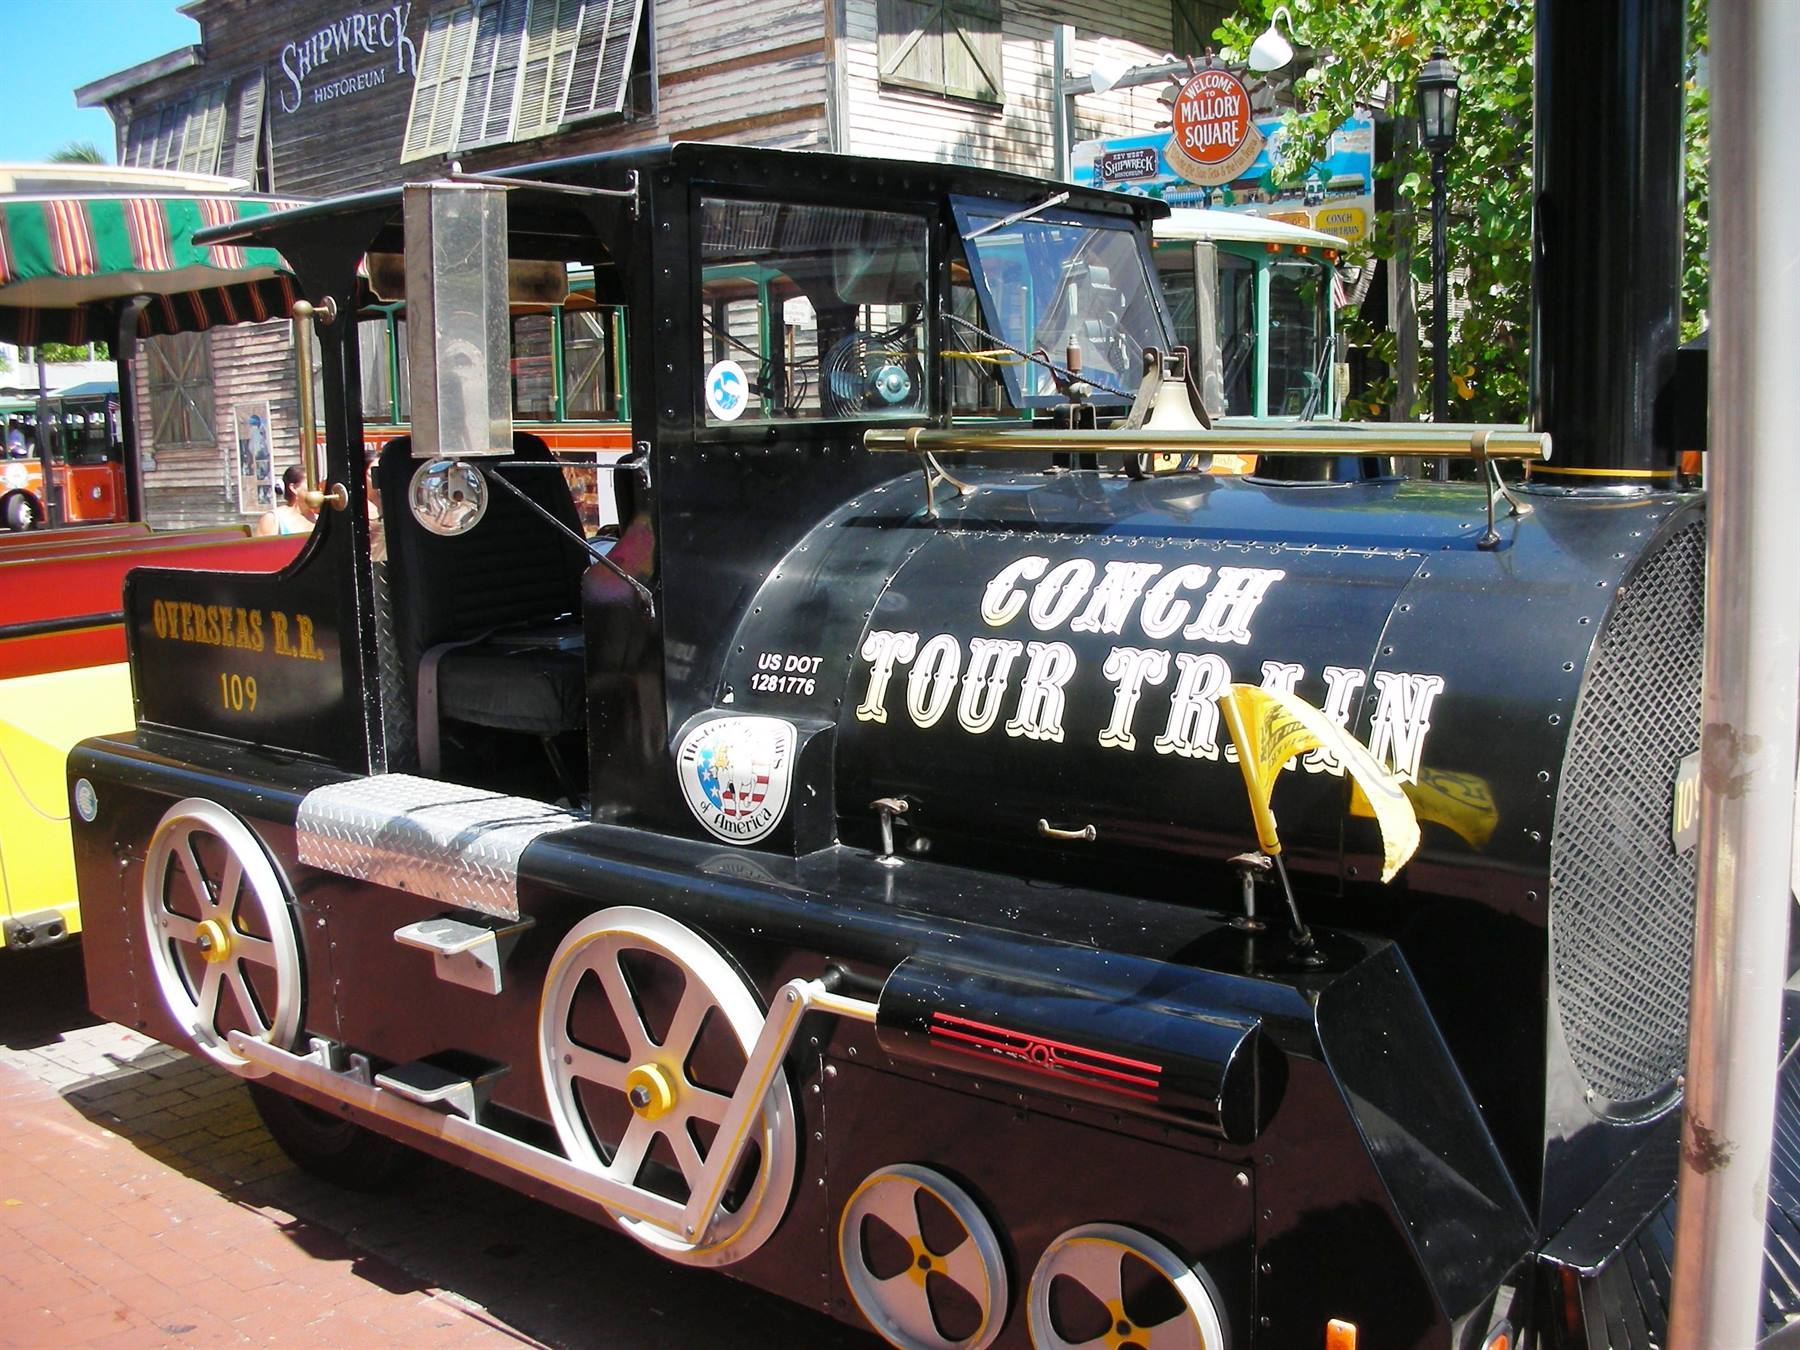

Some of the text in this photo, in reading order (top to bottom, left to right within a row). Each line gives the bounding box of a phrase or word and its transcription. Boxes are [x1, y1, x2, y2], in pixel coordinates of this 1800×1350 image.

[280, 1, 417, 114] SHIPWRECK
[314, 68, 386, 104] HISTOREUM
[1184, 75, 1236, 100] WELCOME
[1205, 90, 1217, 98] TO
[1181, 94, 1241, 124] MALLORY
[1185, 120, 1241, 153] SQUARE
[1105, 155, 1154, 177] SHIPWRECK
[979, 555, 1286, 646] CONCH
[153, 599, 265, 652] OVERSEAS
[757, 652, 824, 674] US DOT
[221, 672, 258, 712] 109
[751, 673, 816, 696] 1281776
[856, 630, 1078, 743] TOUR
[713, 807, 773, 835] America
